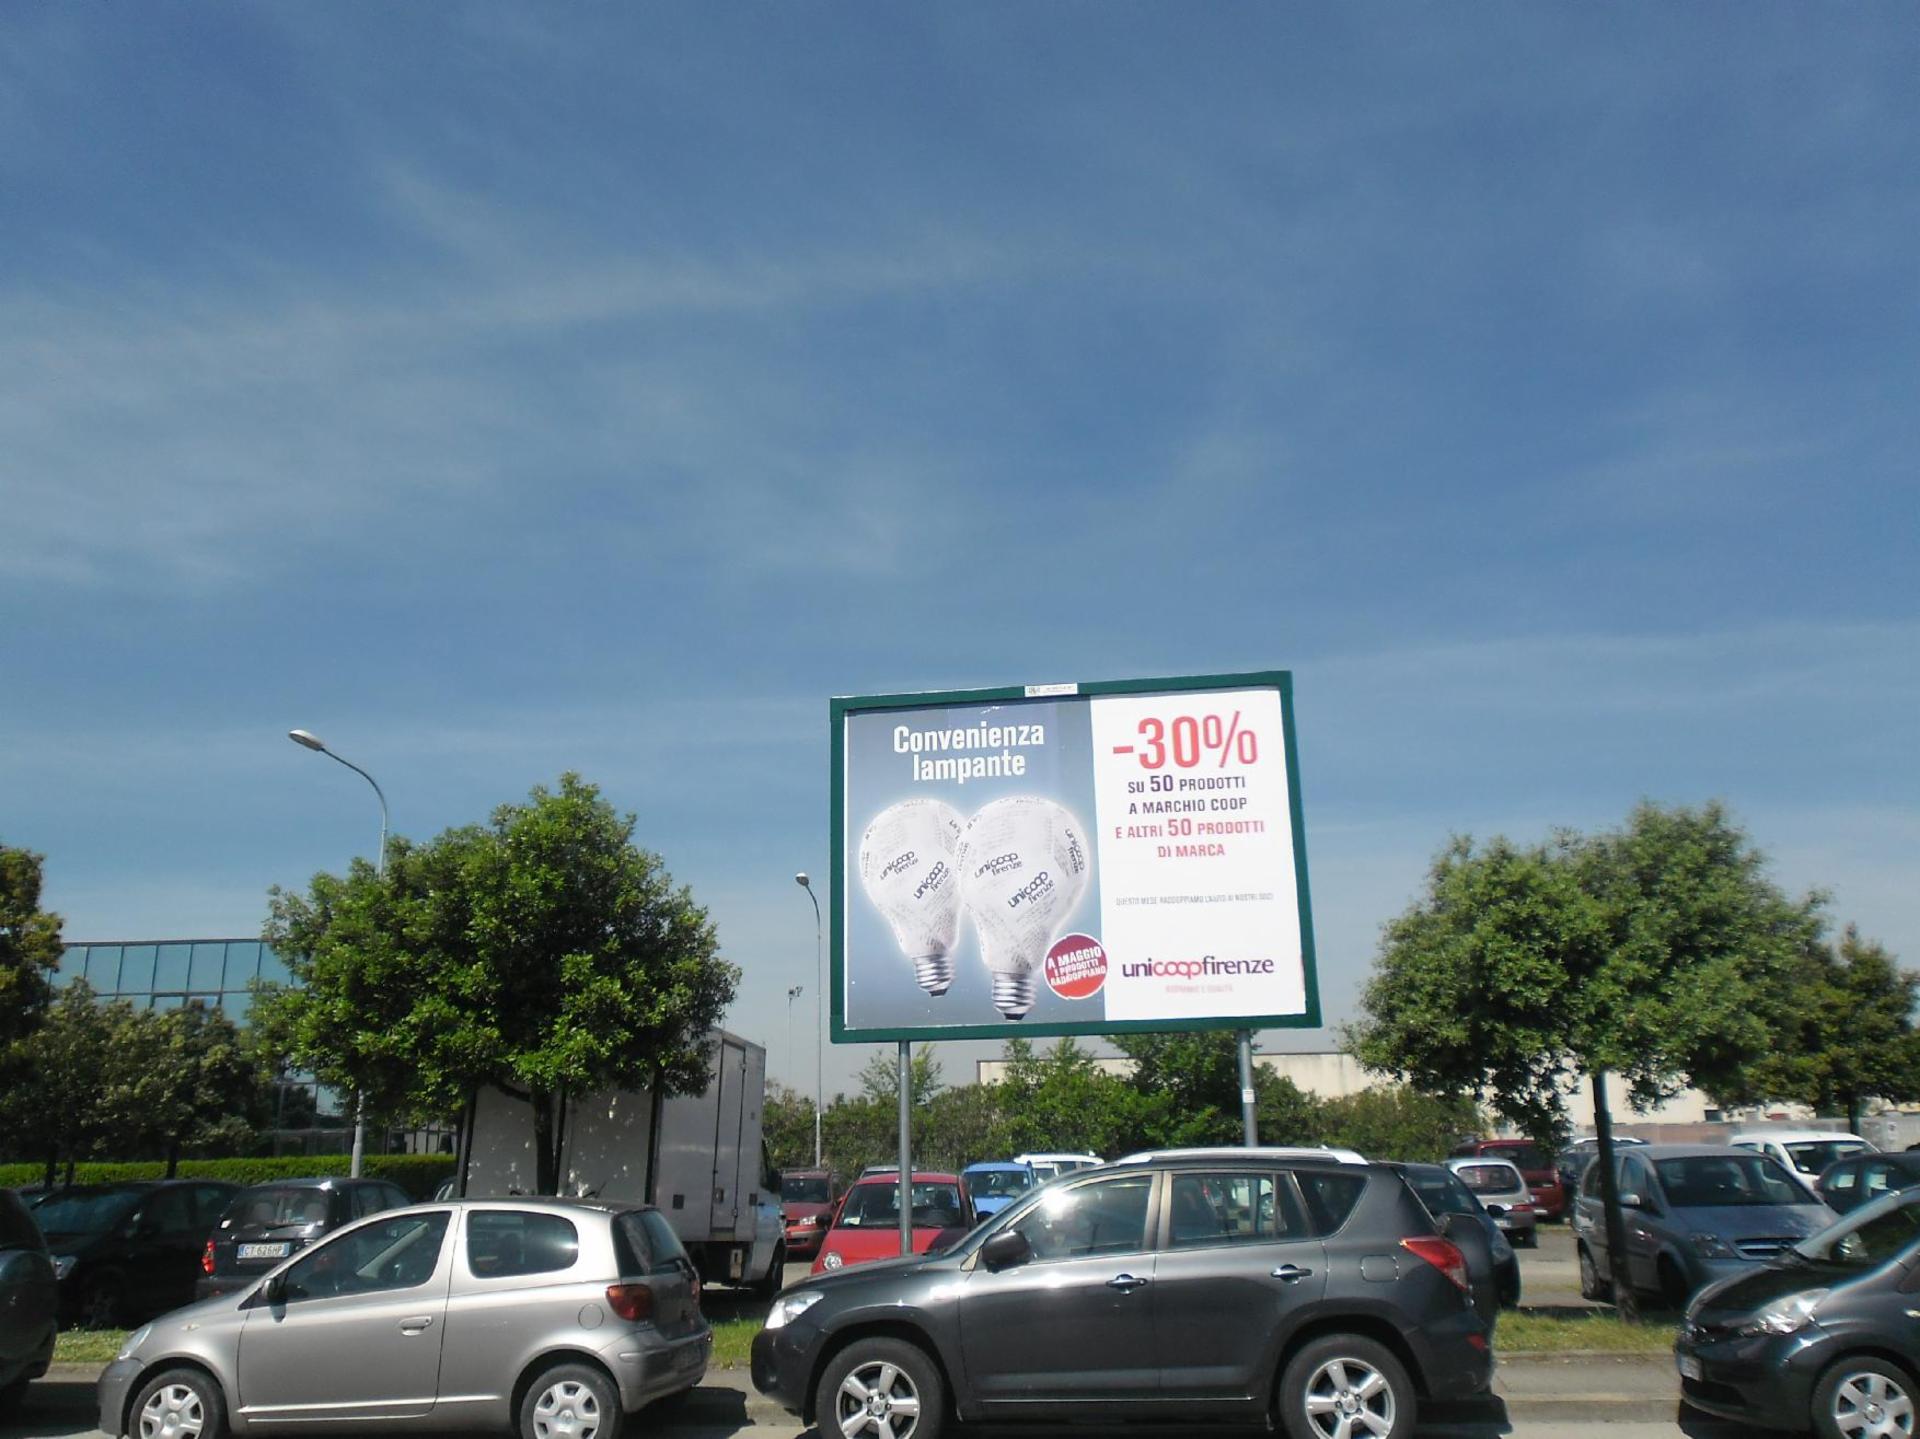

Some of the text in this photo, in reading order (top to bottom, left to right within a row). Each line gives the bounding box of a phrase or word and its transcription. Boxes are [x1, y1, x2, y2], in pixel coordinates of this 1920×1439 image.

[893, 720, 1045, 754] Convenienza
[1112, 710, 1258, 769] -30%
[913, 749, 1026, 784] lampante
[1127, 774, 1246, 794] SU 50 PRODOTTI
[1128, 797, 1248, 815] A MARCHIO COOP
[1115, 818, 1265, 839] E ALTRI 50 PRODOTTI
[1157, 843, 1226, 858] DI MARCA
[974, 852, 1019, 878] unicoop
[913, 861, 944, 899] unicoop
[1007, 871, 1048, 908] unicoop
[1047, 946, 1102, 970] A MAGGIO
[1122, 956, 1274, 980] unicoopfirenze
